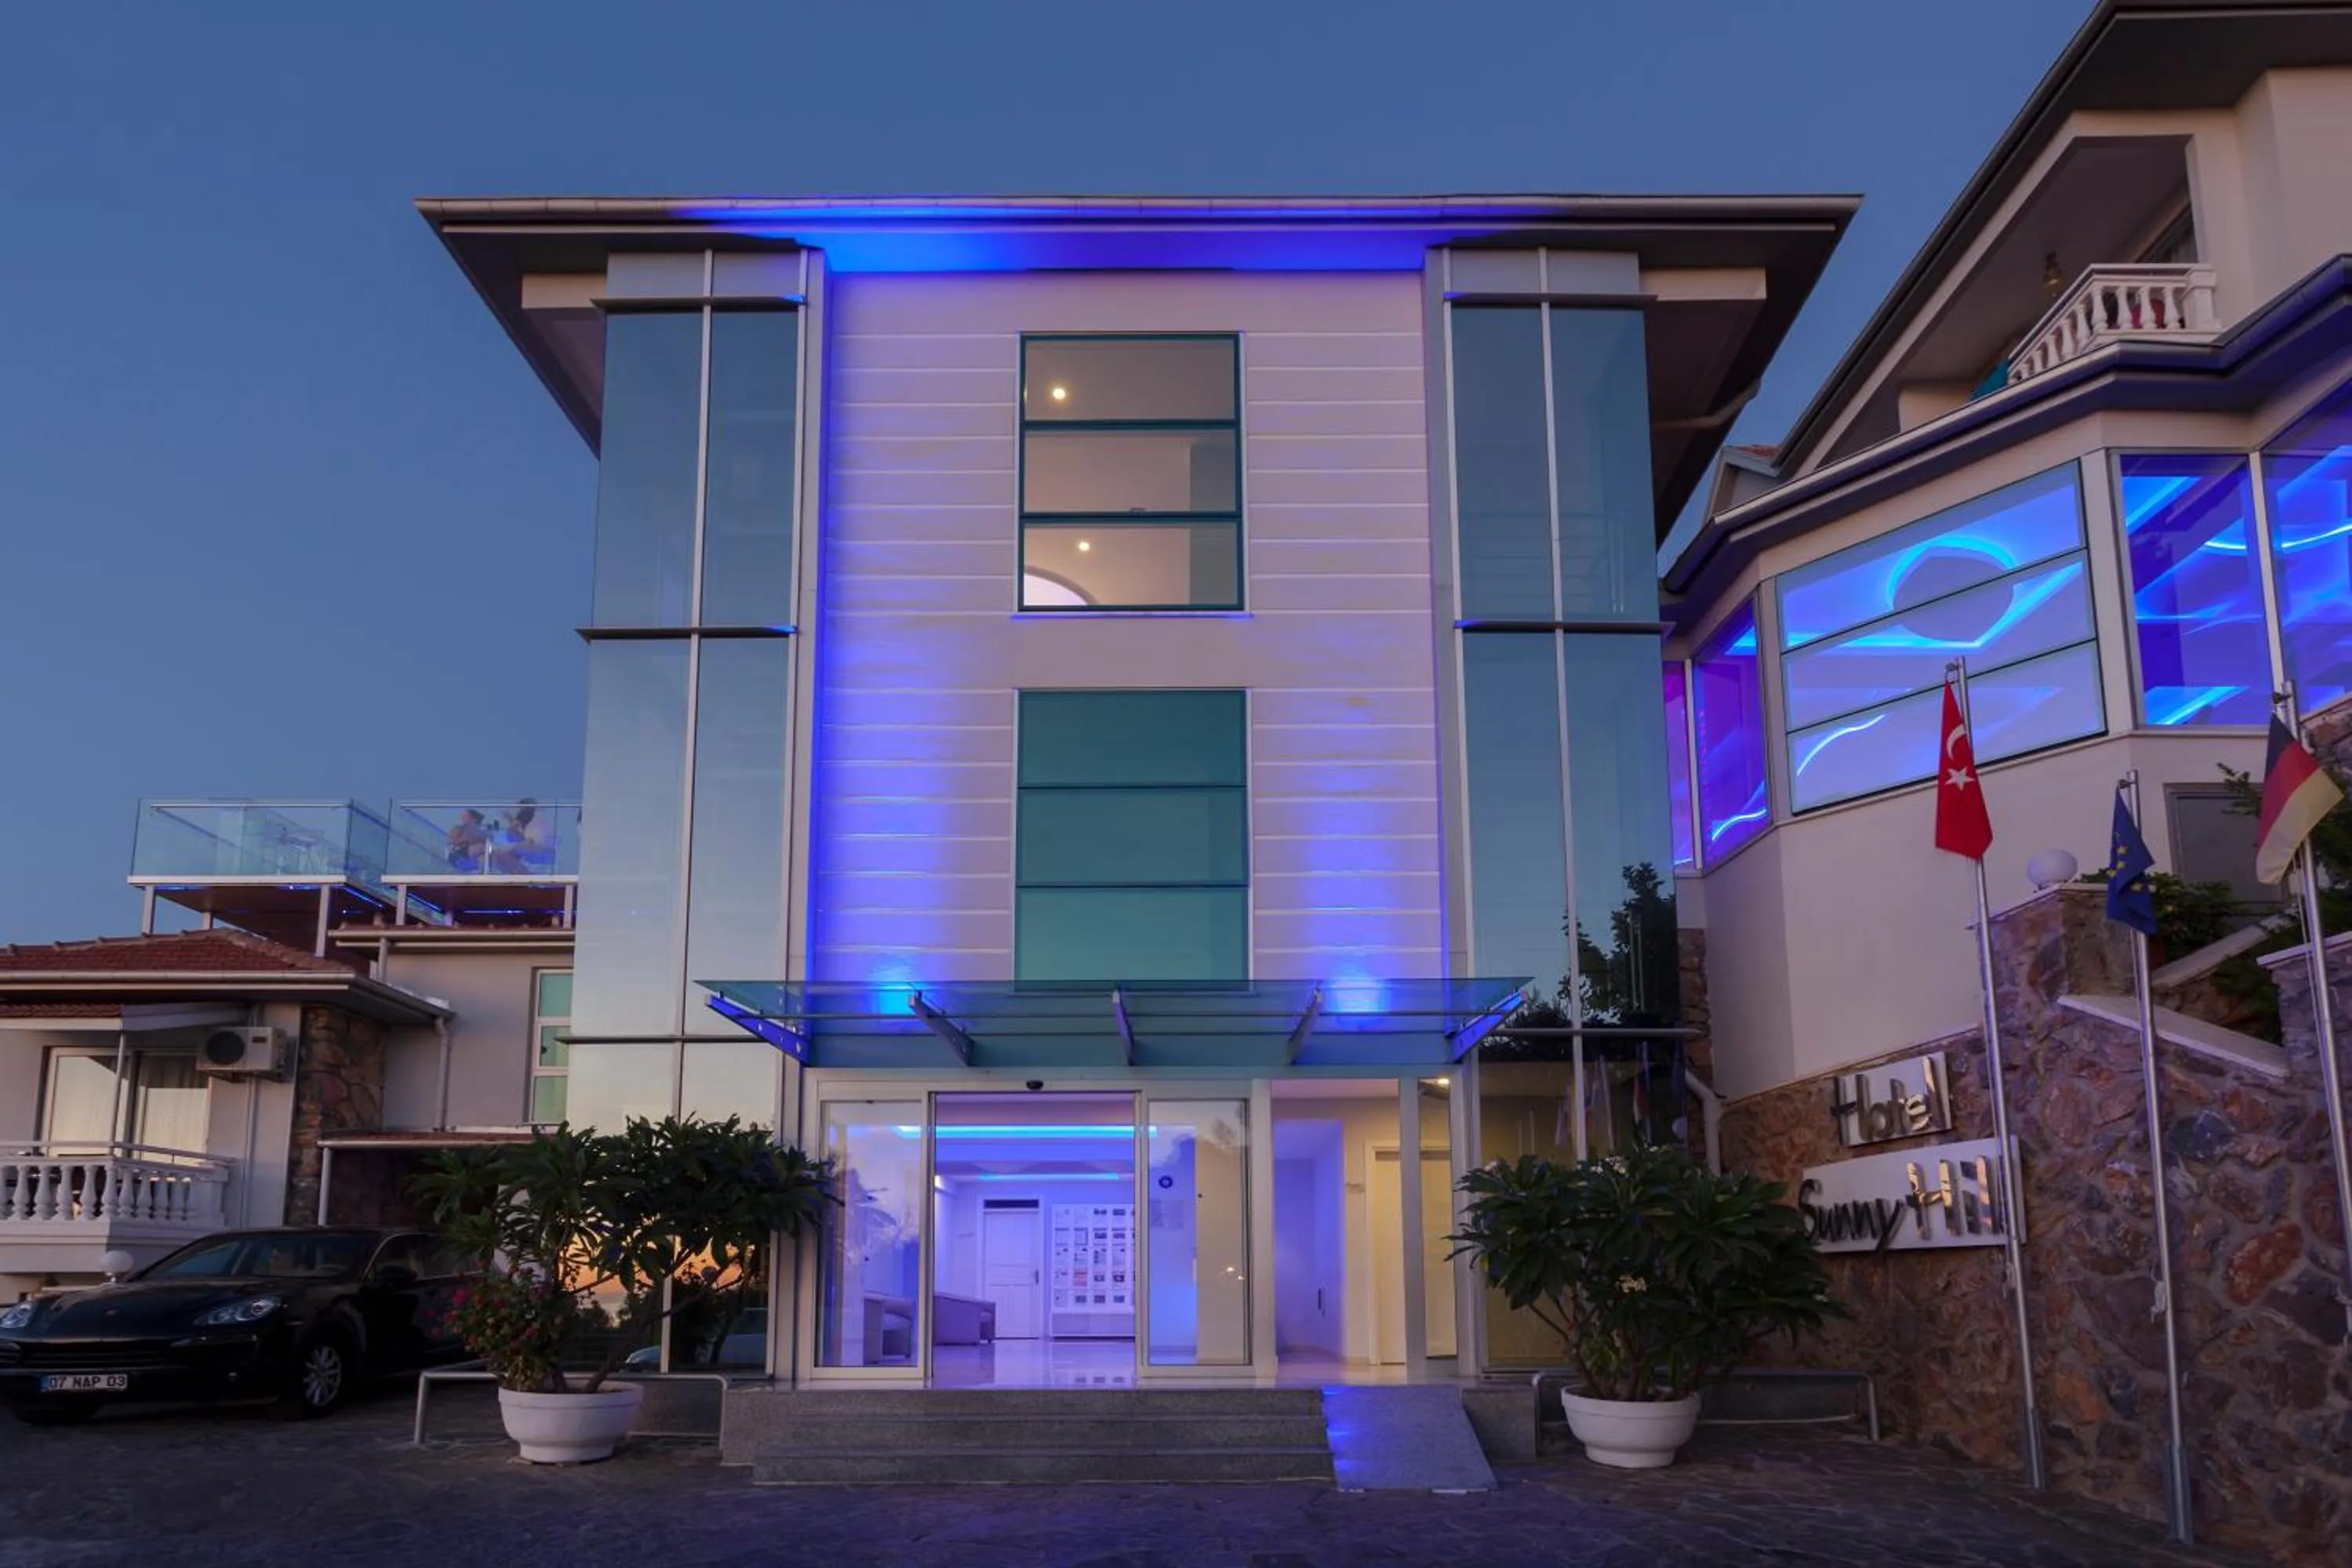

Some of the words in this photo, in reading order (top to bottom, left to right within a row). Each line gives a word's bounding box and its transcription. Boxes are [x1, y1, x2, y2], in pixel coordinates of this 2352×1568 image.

[1830, 1055, 1946, 1146] Hotel
[1798, 1179, 1907, 1251] Sunny
[49, 1377, 67, 1388] 07
[72, 1377, 101, 1388] NAP
[107, 1376, 125, 1387] 03
